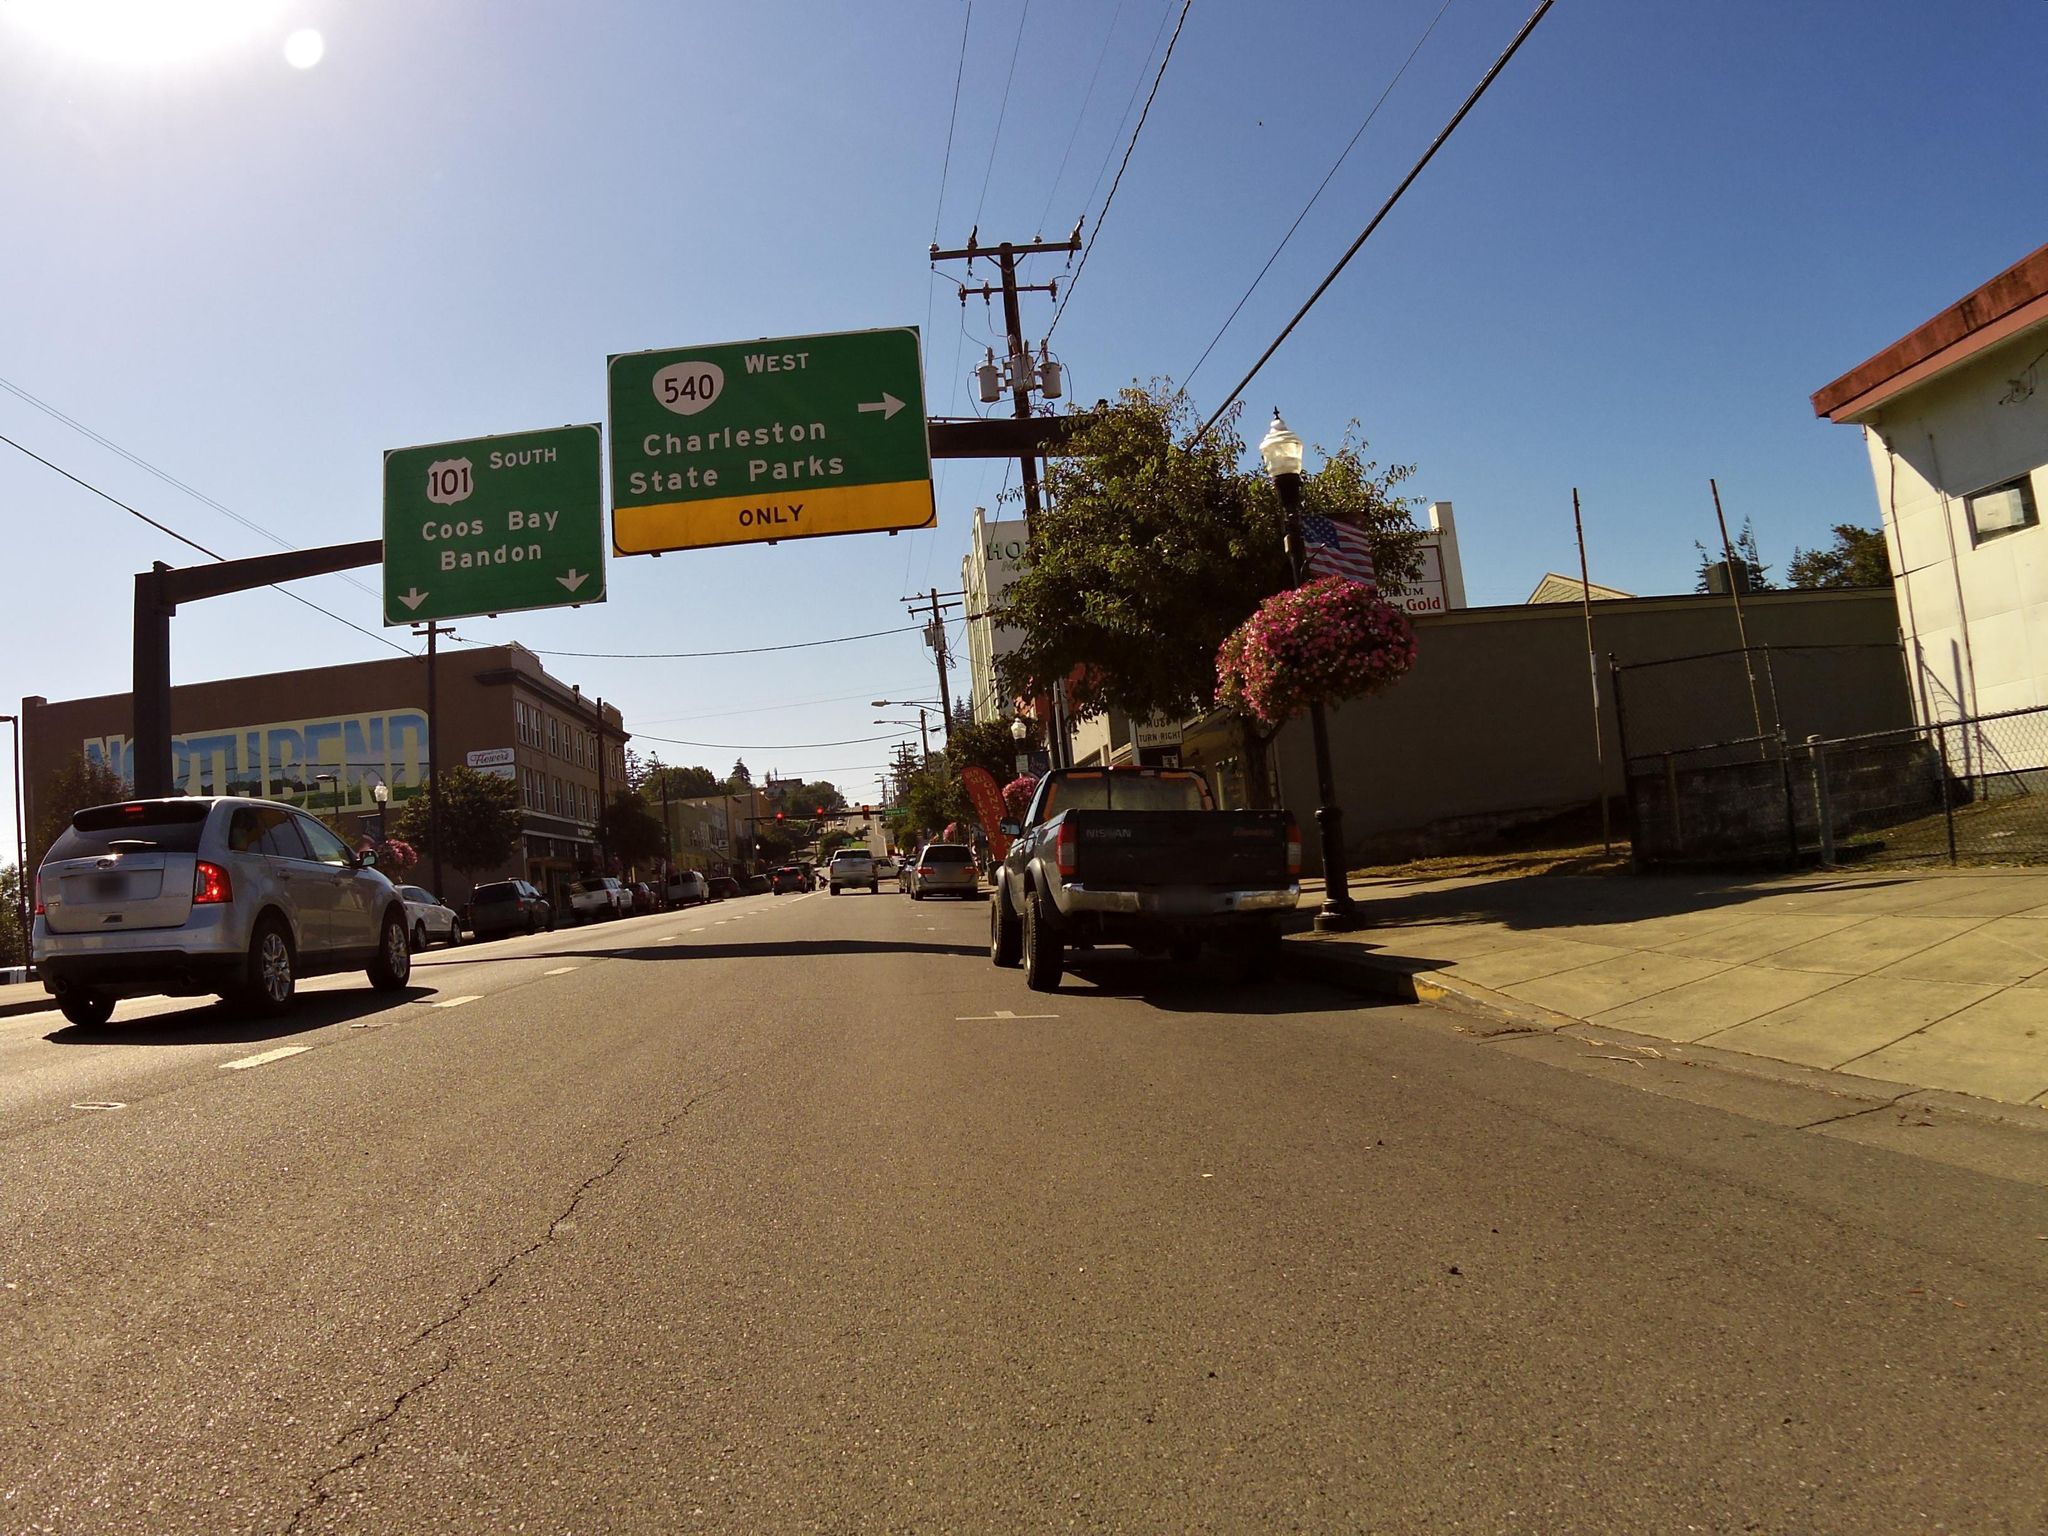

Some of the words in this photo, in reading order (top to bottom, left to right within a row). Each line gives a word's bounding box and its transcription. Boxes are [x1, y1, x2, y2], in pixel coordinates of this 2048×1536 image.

[744, 353, 809, 375] WEST
[663, 373, 715, 404] 540
[643, 422, 827, 457] Charleston
[489, 447, 557, 470] SOUTH
[431, 467, 470, 497] 101
[629, 464, 719, 494] State
[749, 455, 845, 483] Parks
[422, 519, 484, 542] Coos
[508, 509, 560, 531] Bay
[738, 504, 804, 527] ONLY
[440, 542, 542, 571] Bandon
[986, 540, 1030, 561] HO
[1406, 597, 1441, 611] Gold
[1138, 734, 1158, 743] TURN
[1160, 731, 1181, 741] RIGHT
[83, 729, 263, 798] NRTH
[265, 711, 430, 811] BEND
